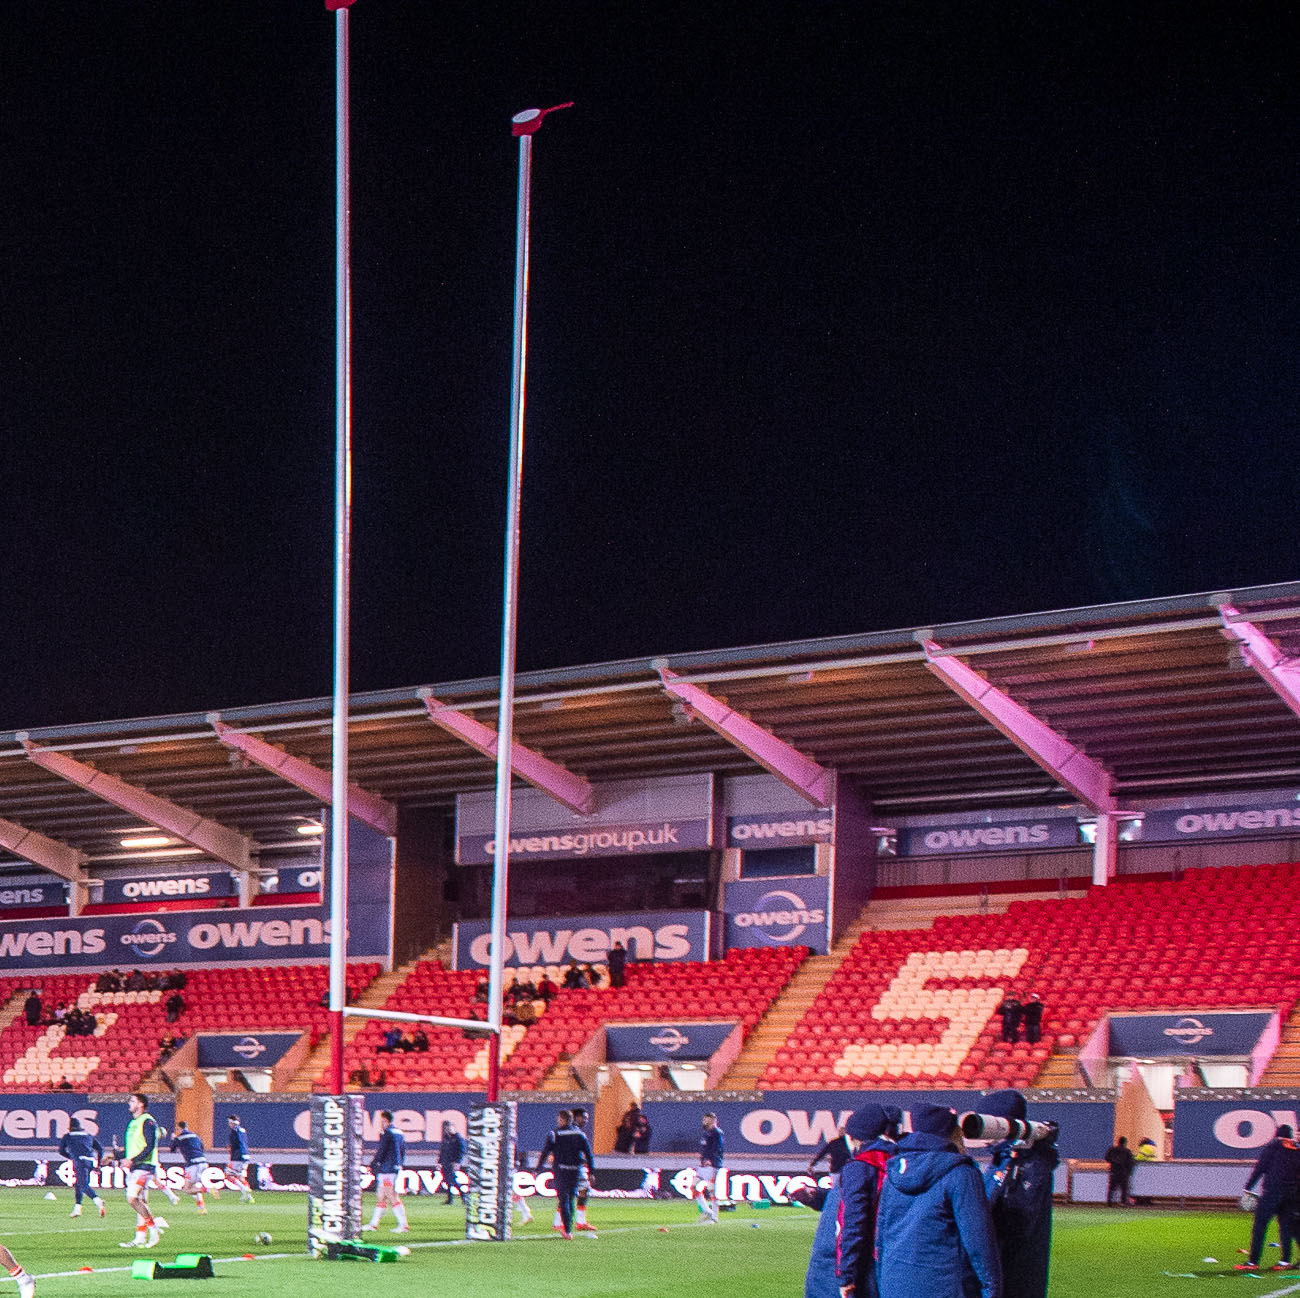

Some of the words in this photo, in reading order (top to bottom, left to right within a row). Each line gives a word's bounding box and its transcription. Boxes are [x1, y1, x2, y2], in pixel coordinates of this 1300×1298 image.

[732, 817, 832, 840] owens
[925, 823, 1049, 849] owens
[122, 877, 211, 898] owens
[734, 907, 824, 927] owens
[120, 931, 176, 944] owens
[187, 917, 349, 949] owen
[470, 922, 690, 965] owens
[324, 1098, 345, 1135] CUP
[322, 1138, 343, 1232] CHALLENGE
[478, 1136, 500, 1225] CHALLENGE
